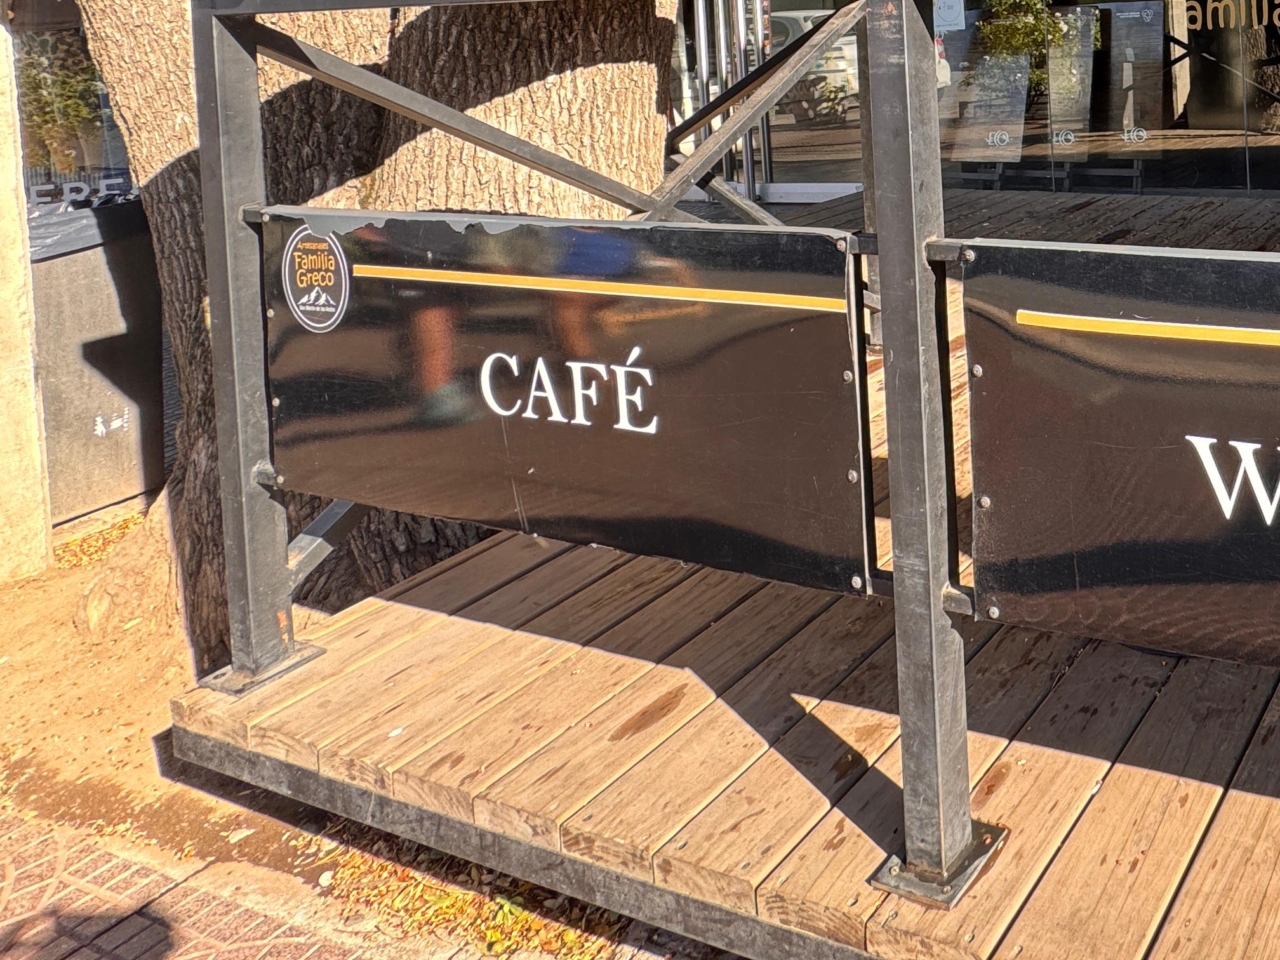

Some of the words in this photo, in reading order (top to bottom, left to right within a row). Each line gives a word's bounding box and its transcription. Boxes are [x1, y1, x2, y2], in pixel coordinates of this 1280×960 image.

[293, 251, 335, 271] Familia
[296, 269, 334, 288] Greco
[480, 347, 659, 435] CAFÉ
